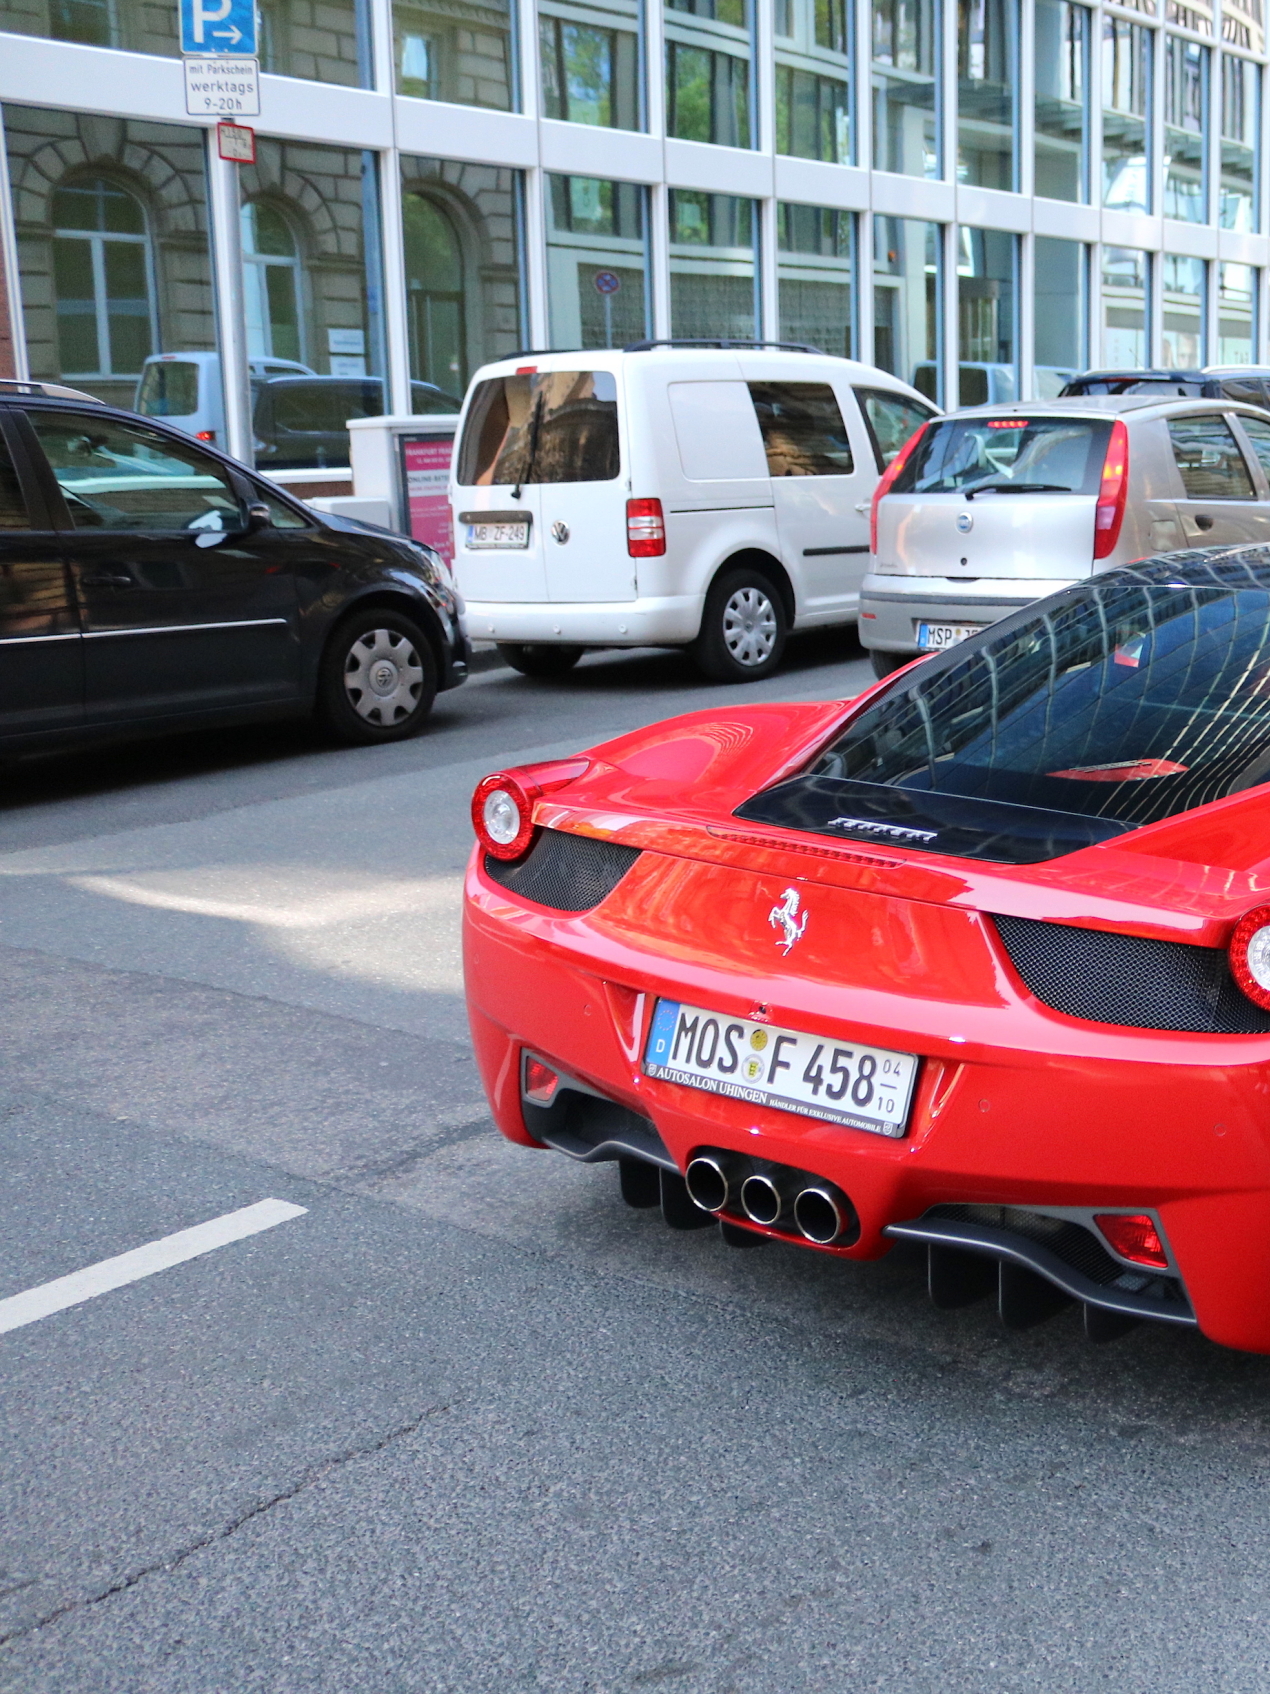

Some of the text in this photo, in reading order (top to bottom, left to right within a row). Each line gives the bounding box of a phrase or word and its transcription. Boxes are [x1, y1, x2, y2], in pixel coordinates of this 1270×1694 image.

[189, 63, 253, 75] mit Parkschein
[191, 80, 254, 95] werktags
[474, 525, 525, 541] MB ZF-249
[928, 627, 952, 646] MSP
[655, 1038, 666, 1053] D
[672, 1012, 877, 1108] MOS F 458
[882, 1058, 901, 1076] 04
[657, 1067, 718, 1092] AUTOSALON
[719, 1081, 768, 1105] UHINGEN
[808, 1108, 842, 1123] EXKLUSIVE
[841, 1116, 882, 1133] AUTOMOBILE
[878, 1096, 895, 1114] 10
